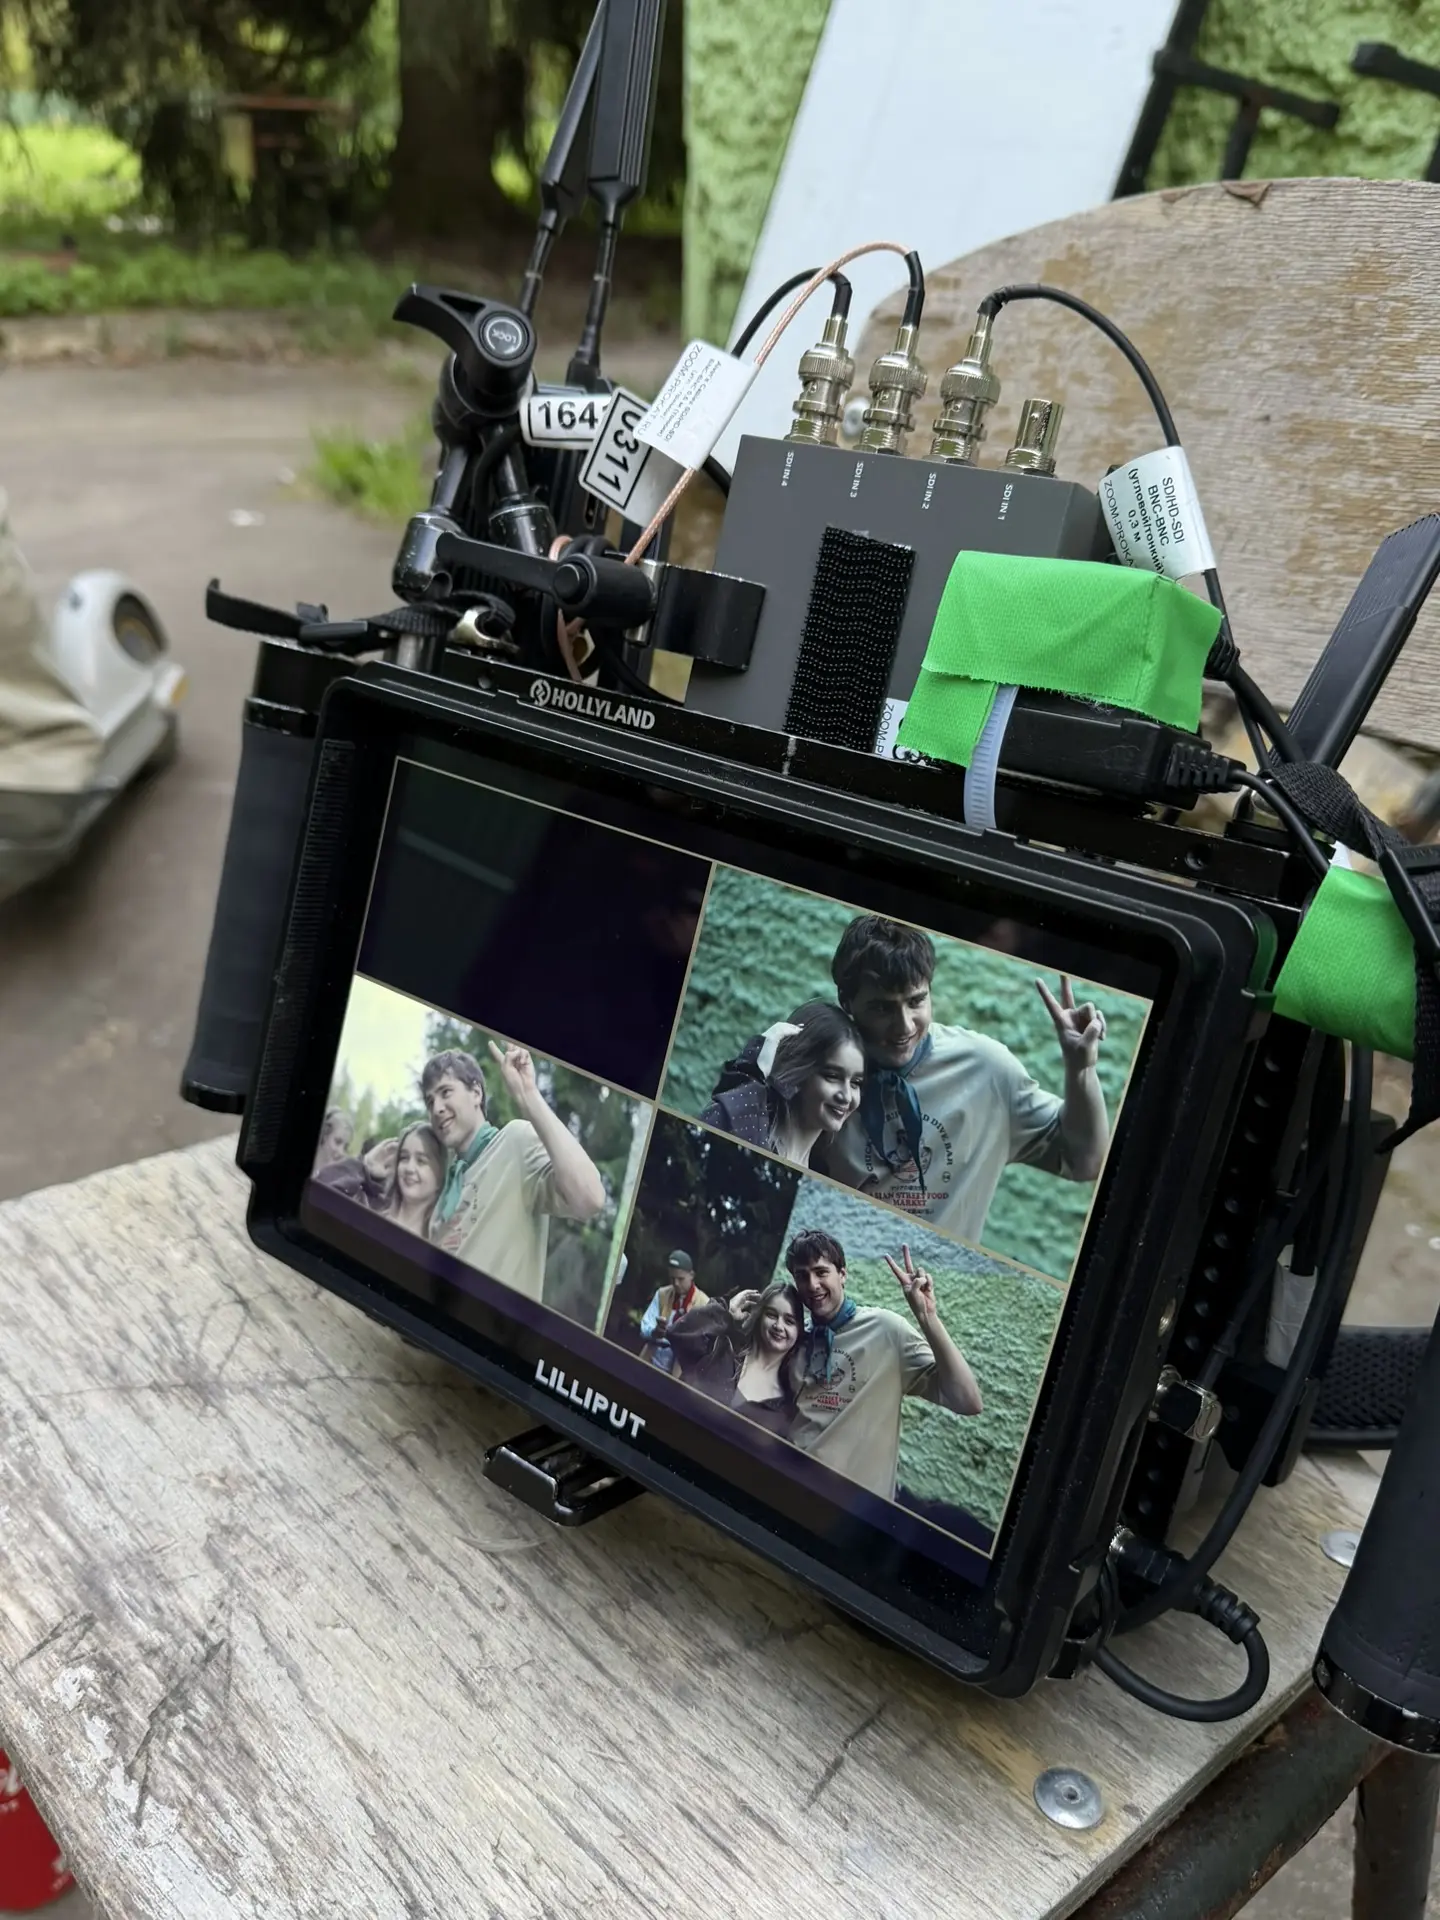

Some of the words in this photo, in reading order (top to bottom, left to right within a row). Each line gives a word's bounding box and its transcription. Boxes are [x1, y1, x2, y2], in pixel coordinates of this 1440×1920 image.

[538, 401, 608, 429] 164
[786, 452, 794, 467] SDI
[854, 462, 864, 478] SDI
[926, 472, 936, 488] SDI
[1002, 484, 1012, 500] SDI
[1104, 480, 1135, 569] ZOOM-PROKA
[1128, 509, 1139, 529] 0,3
[1128, 468, 1166, 575] (угловой/тонкий)
[1148, 484, 1170, 546] BNC-BNC
[1162, 477, 1185, 544] SD/HD-SDI
[551, 687, 655, 730] HOLLYLAND
[875, 704, 895, 756] ZOOM-P
[931, 1118, 949, 1141] DIVE
[944, 1142, 954, 1165] BAR
[893, 1199, 926, 1207] MARKET
[927, 1191, 949, 1200] FOOD
[535, 1359, 646, 1439] LILLIPUT
